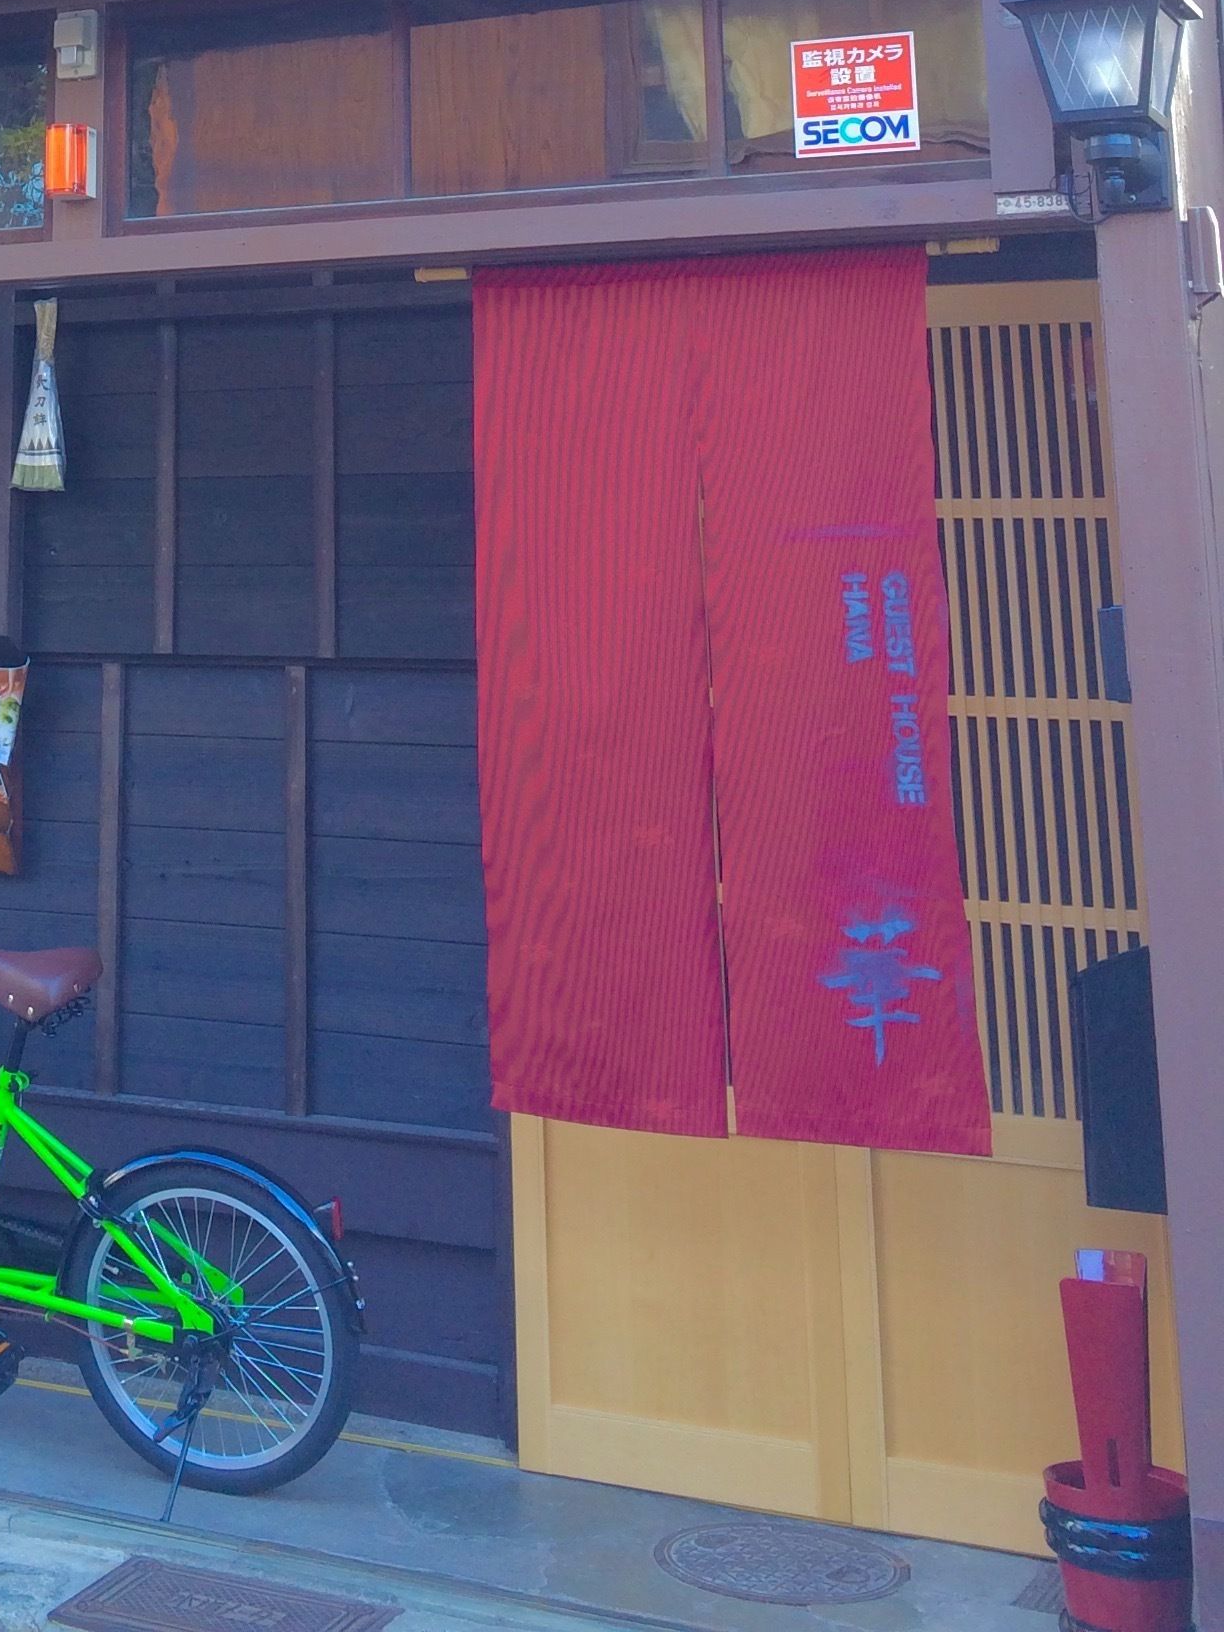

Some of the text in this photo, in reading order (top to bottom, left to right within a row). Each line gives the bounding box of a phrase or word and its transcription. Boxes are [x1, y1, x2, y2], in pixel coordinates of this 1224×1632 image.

[802, 43, 904, 69] 監視カメラ
[829, 65, 877, 86] 設置
[847, 85, 873, 95] Camera
[802, 114, 910, 146] SECOM
[841, 571, 874, 665] HANA
[881, 570, 927, 806] GUEST HOUSE
